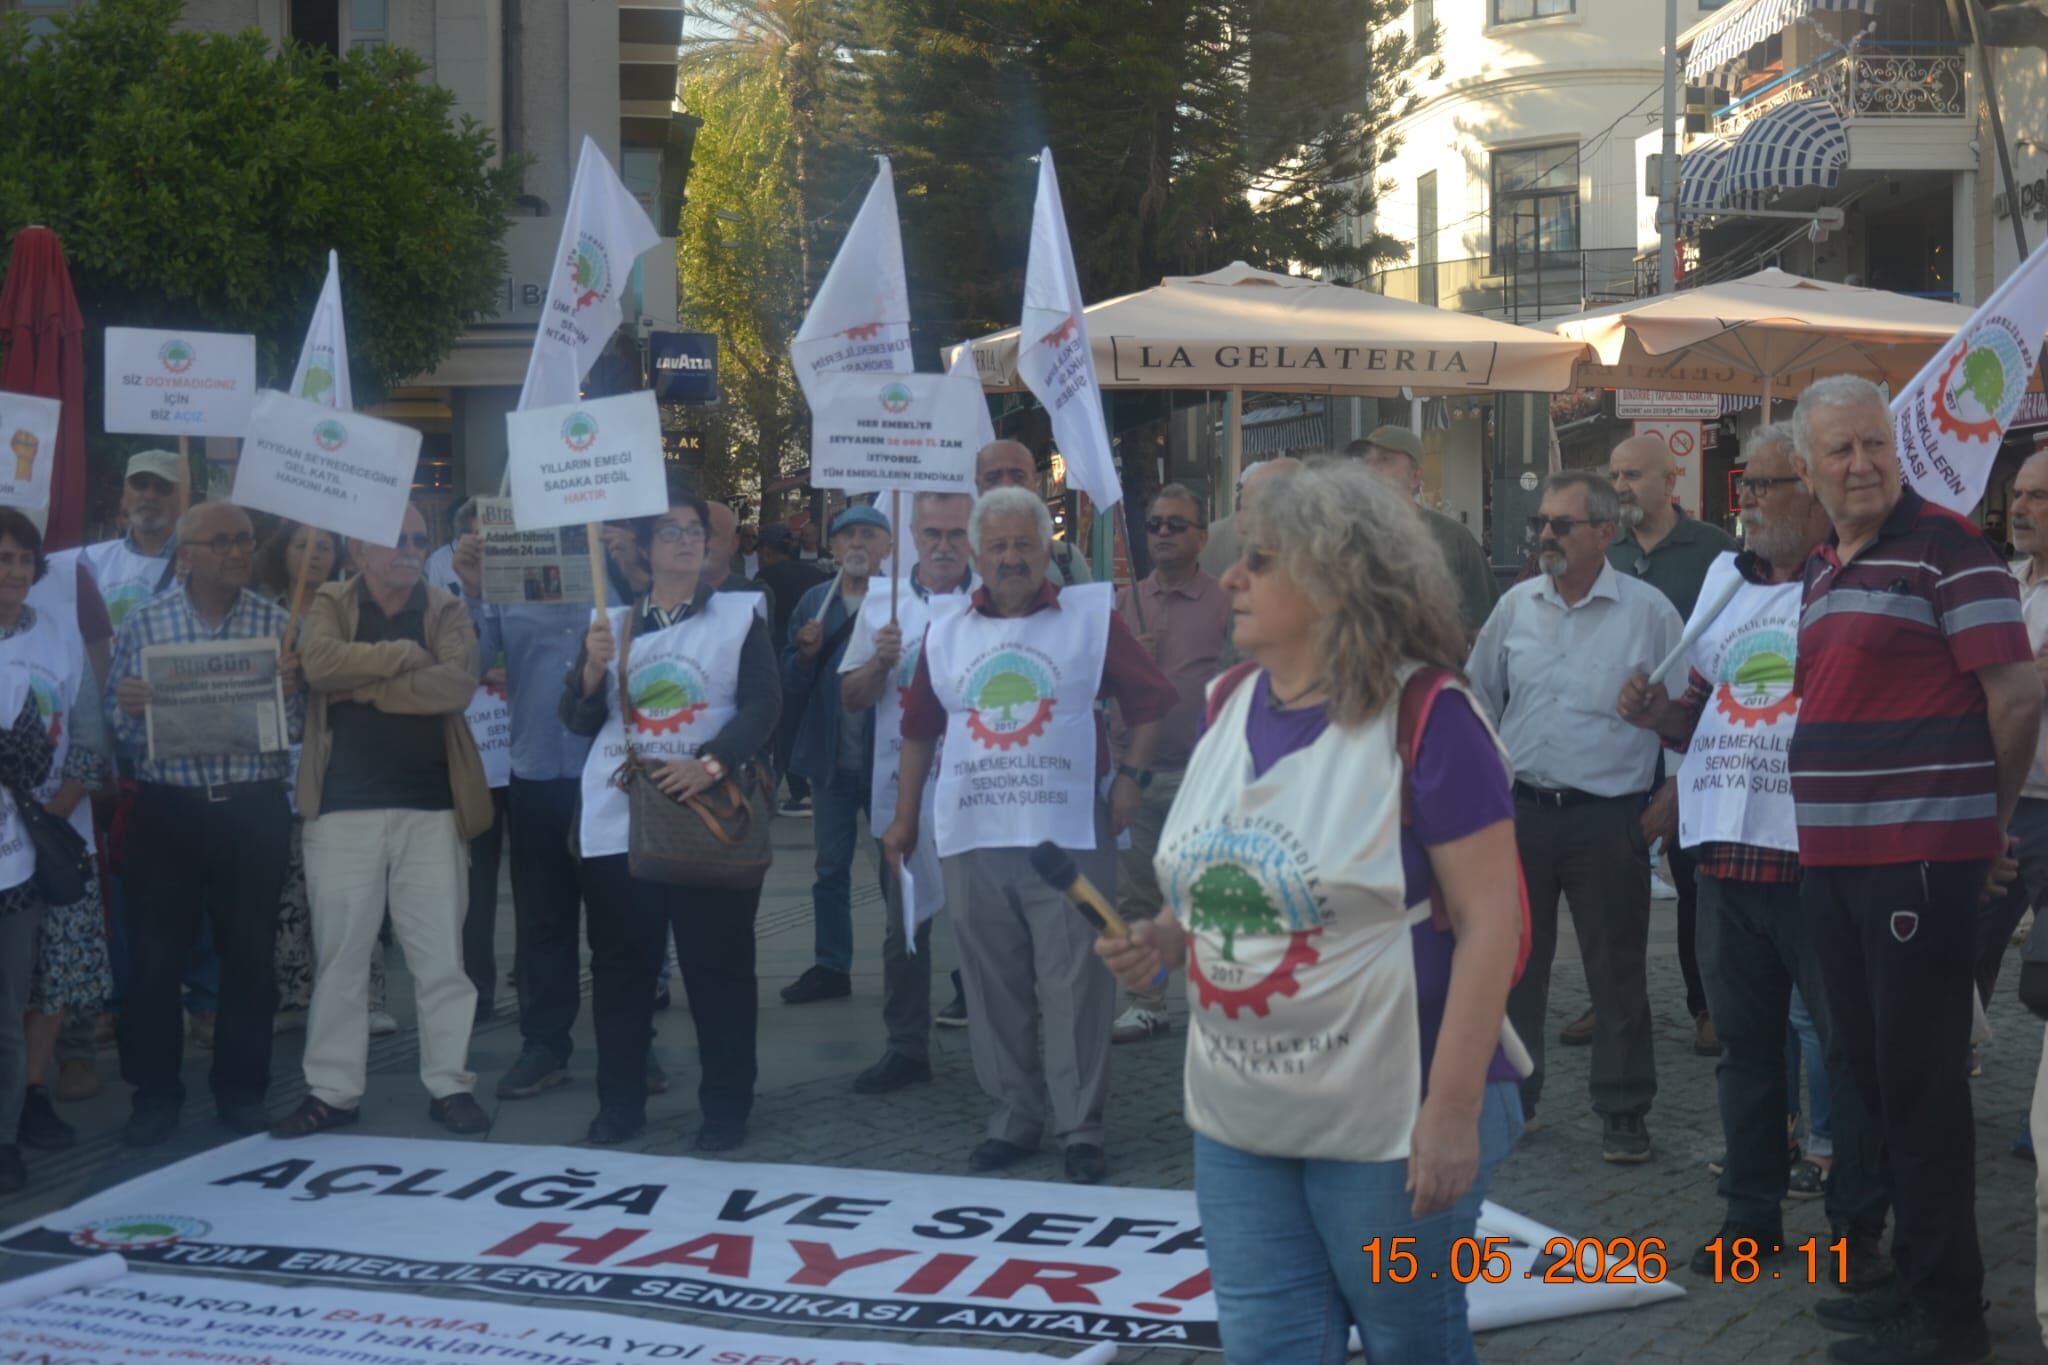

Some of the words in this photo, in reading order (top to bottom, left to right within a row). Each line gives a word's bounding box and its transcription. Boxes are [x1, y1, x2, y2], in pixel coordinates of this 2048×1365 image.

[656, 353, 713, 370] LAVAZZA
[1139, 345, 1194, 368] LA
[1215, 345, 1469, 373] GELATERIA
[164, 391, 190, 406] İÇİN
[151, 409, 171, 421] BİZ
[940, 439, 963, 449] ZAM
[284, 460, 307, 476] GEL
[539, 457, 592, 475] YILLARIN
[823, 467, 844, 478] TÜM
[323, 483, 348, 500] ARA
[544, 476, 592, 492] SADAKA
[563, 488, 607, 505] HAKTIR
[1694, 734, 1717, 752] TÜM
[954, 758, 980, 776] TÜM
[980, 752, 1072, 772] EMEKLİLERİN
[1705, 755, 1788, 774] SENDİKASI
[971, 773, 1044, 791] SENDİKASI
[959, 790, 1016, 810] ANTALYA
[1018, 789, 1069, 807] ŞUBESİ
[1210, 964, 1244, 985] 2017
[207, 1157, 668, 1216] AÇLIĞA
[717, 1189, 893, 1231] VE
[161, 1244, 268, 1268] TÜM
[278, 1252, 611, 1295] EMEKLİLERİN
[631, 1279, 920, 1323] SENDİKASI
[937, 1306, 1189, 1341] ANTALYA
[192, 1319, 347, 1338] yaşam
